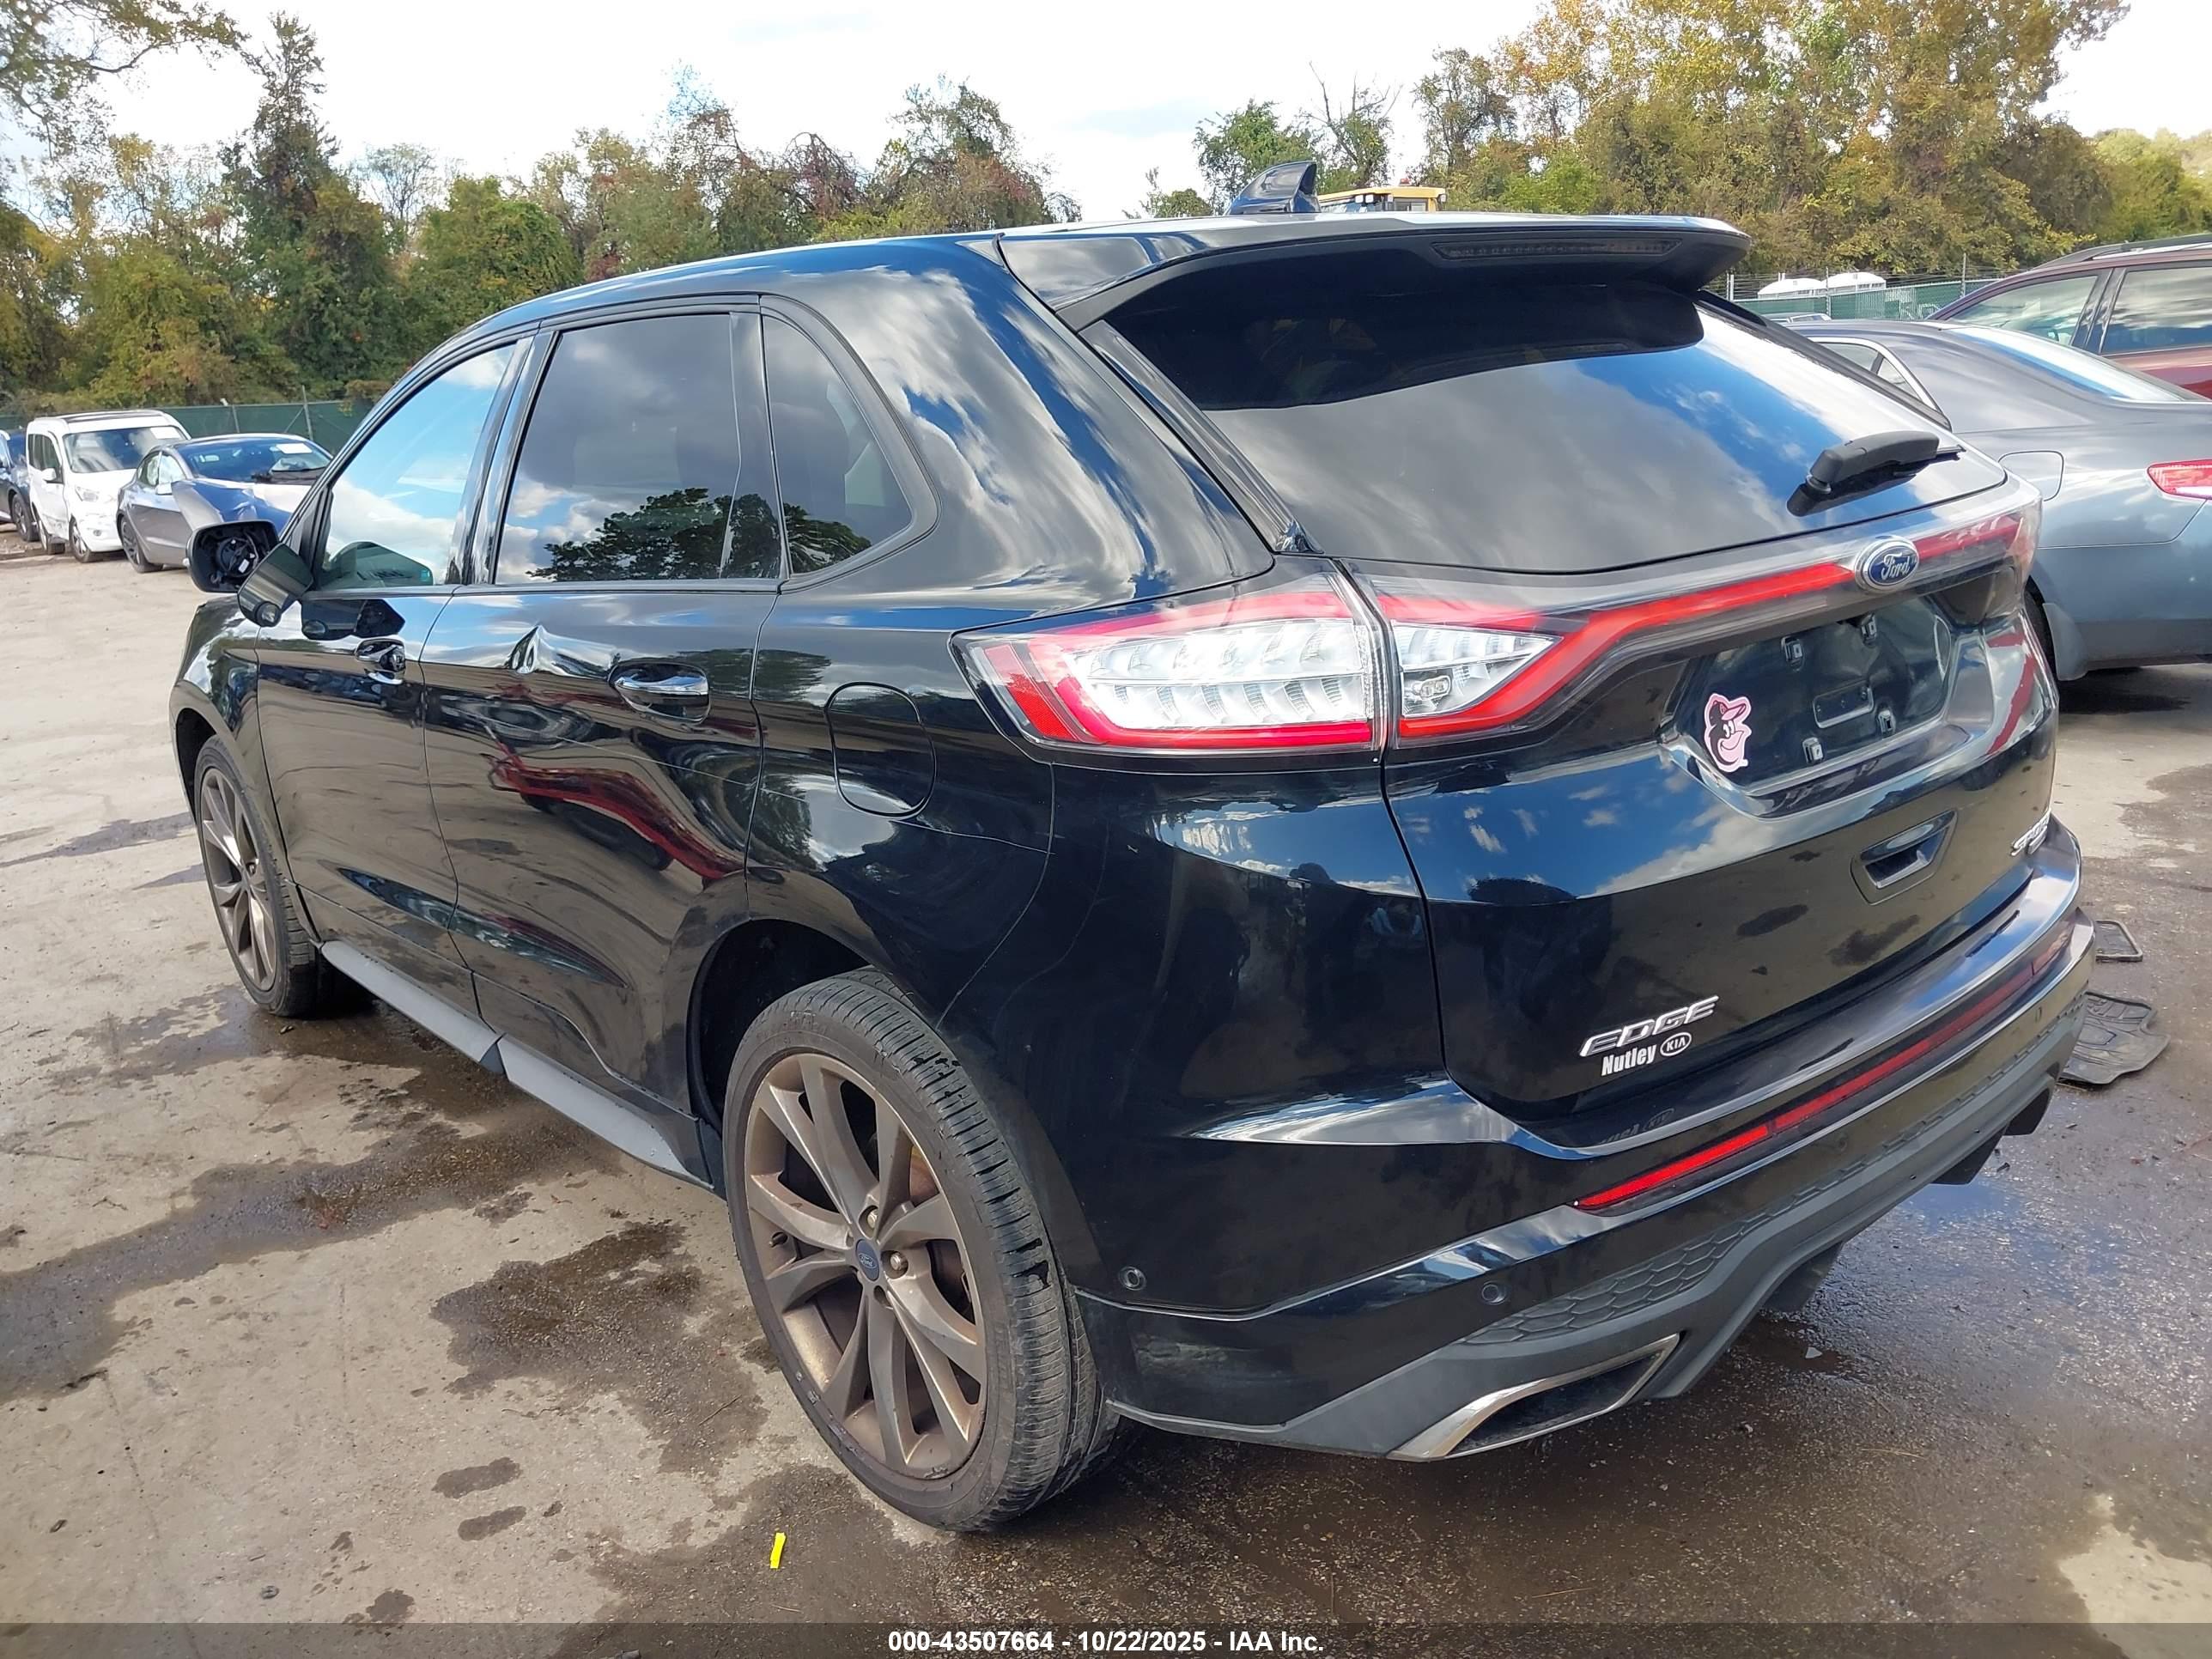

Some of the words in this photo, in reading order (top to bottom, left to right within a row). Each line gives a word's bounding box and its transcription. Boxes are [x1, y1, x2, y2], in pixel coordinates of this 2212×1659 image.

[1881, 551, 1910, 580] Ford
[1579, 995, 1719, 1057] EDGE
[1601, 1044, 1657, 1077] Nutley
